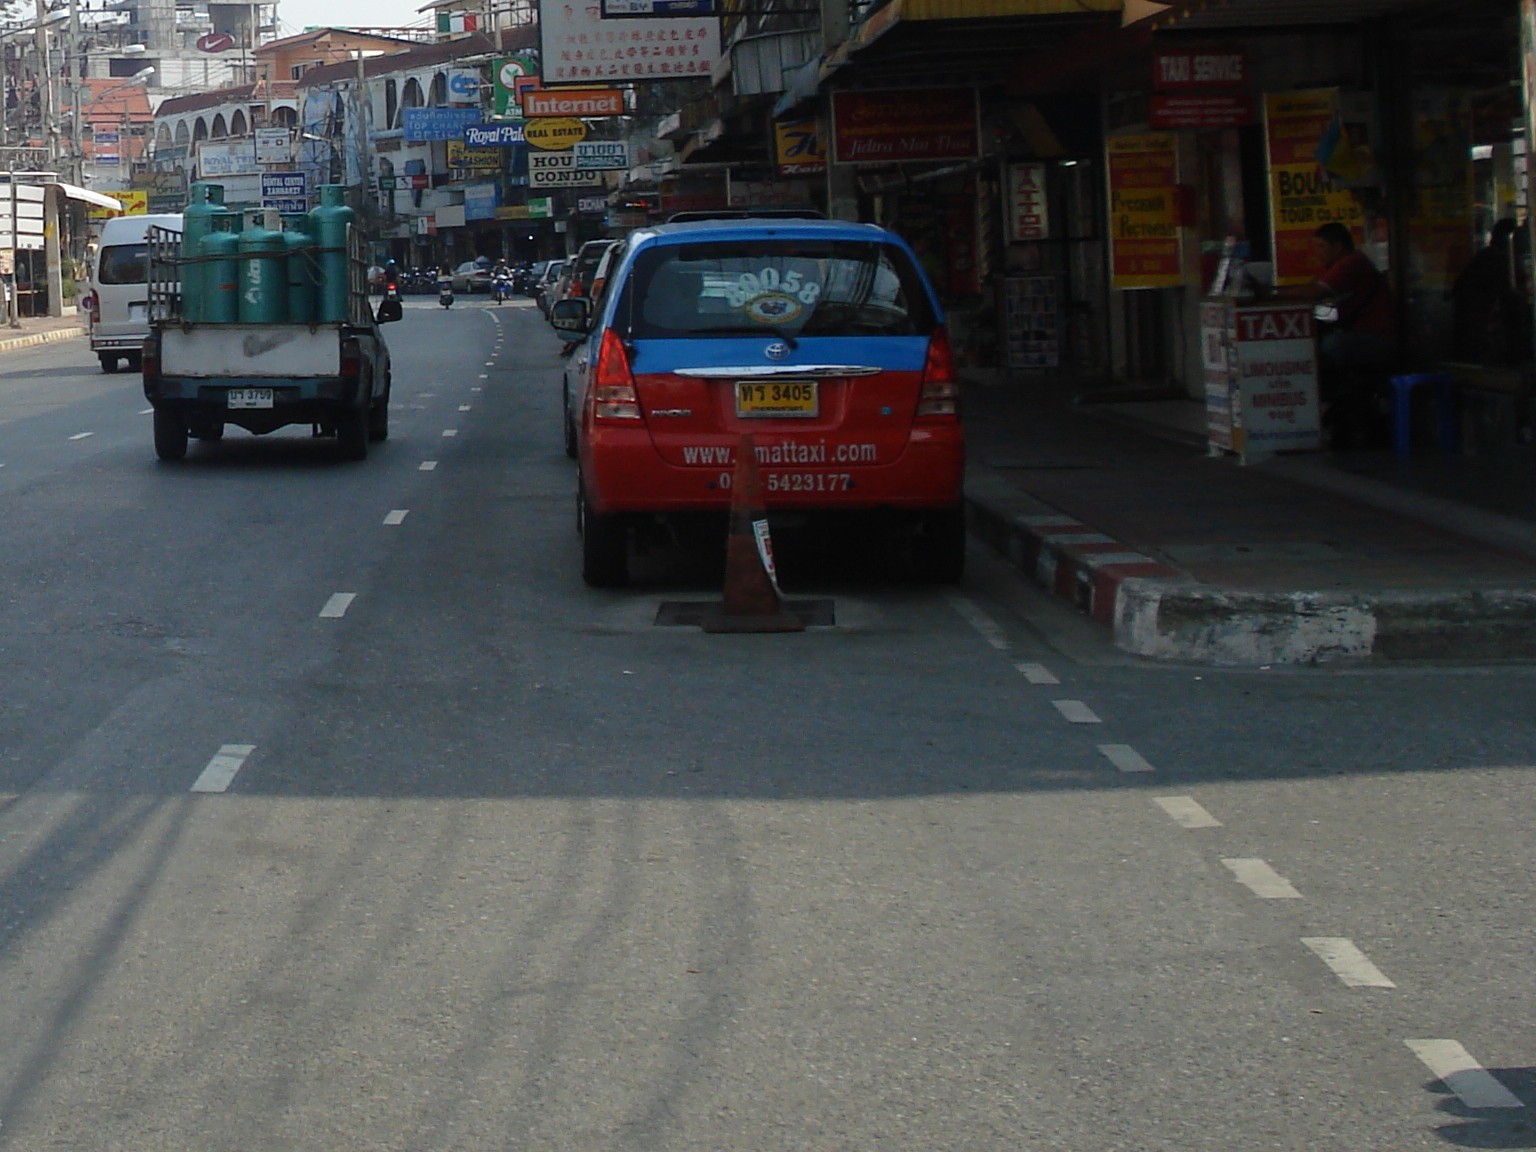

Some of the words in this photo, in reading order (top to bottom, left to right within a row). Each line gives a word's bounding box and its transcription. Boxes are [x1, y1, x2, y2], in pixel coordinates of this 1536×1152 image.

[1193, 53, 1243, 82] SERVICE
[527, 95, 618, 114] Internet
[466, 127, 500, 145] Royal
[527, 129, 549, 138] REAL
[552, 127, 583, 137] ESTATE
[534, 171, 596, 182] CONDO
[1016, 165, 1043, 239] TATTOO
[1240, 312, 1312, 339] TAXI
[1242, 360, 1313, 379] LIMOUSINE
[771, 384, 812, 402] 3405
[767, 472, 851, 491] 5423177
